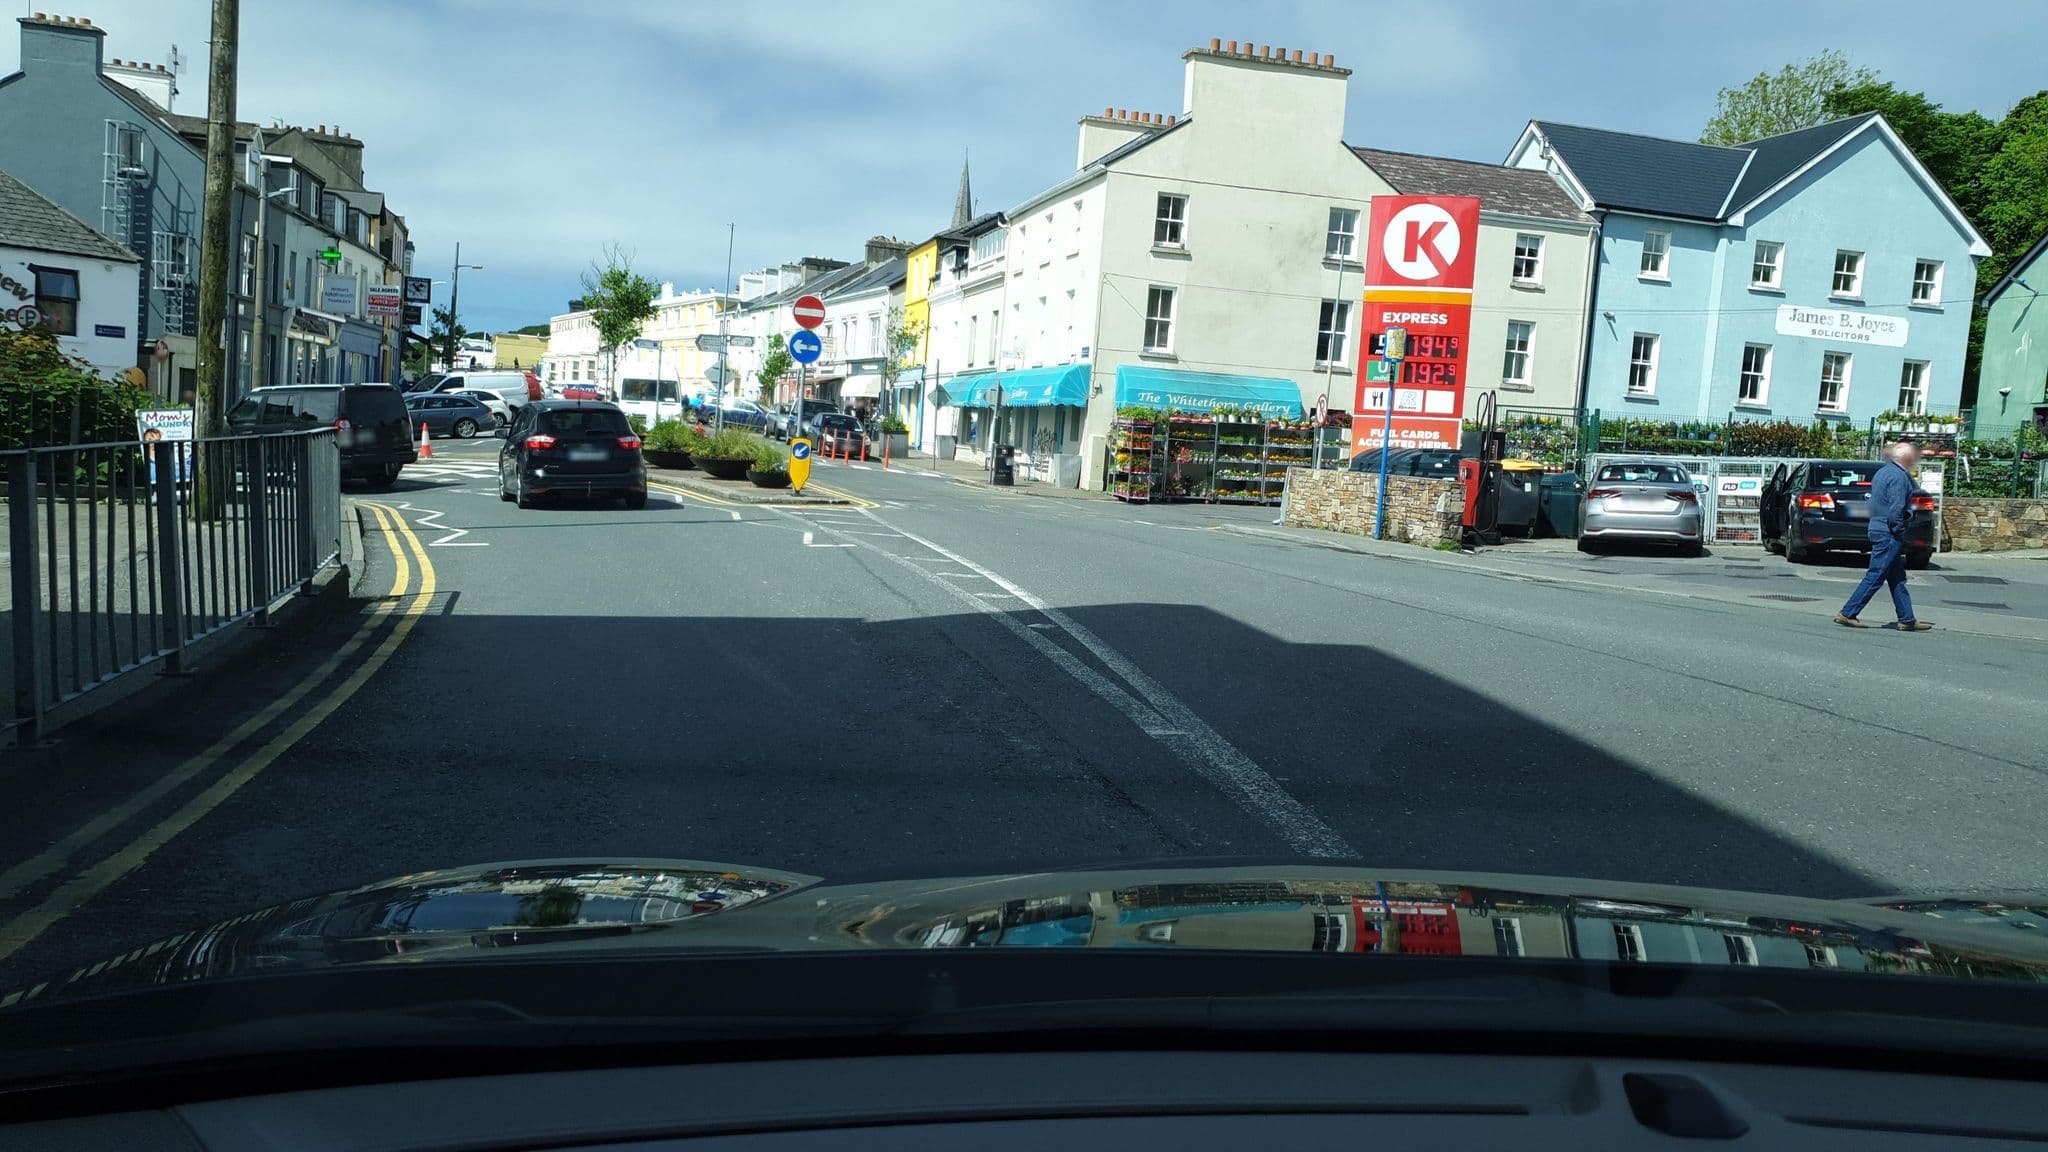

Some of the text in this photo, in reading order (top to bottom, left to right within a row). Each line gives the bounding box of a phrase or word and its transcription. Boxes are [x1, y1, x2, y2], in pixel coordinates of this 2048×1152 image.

[1403, 221, 1449, 273] K
[1382, 311, 1449, 325] EXPRESS
[1789, 308, 1896, 333] James B. Joyce
[1811, 329, 1870, 341] SOLICITORS
[1138, 391, 1291, 415] The Whitethorn Gallery
[146, 411, 190, 422] Mom's
[1401, 430, 1440, 440] CARDS
